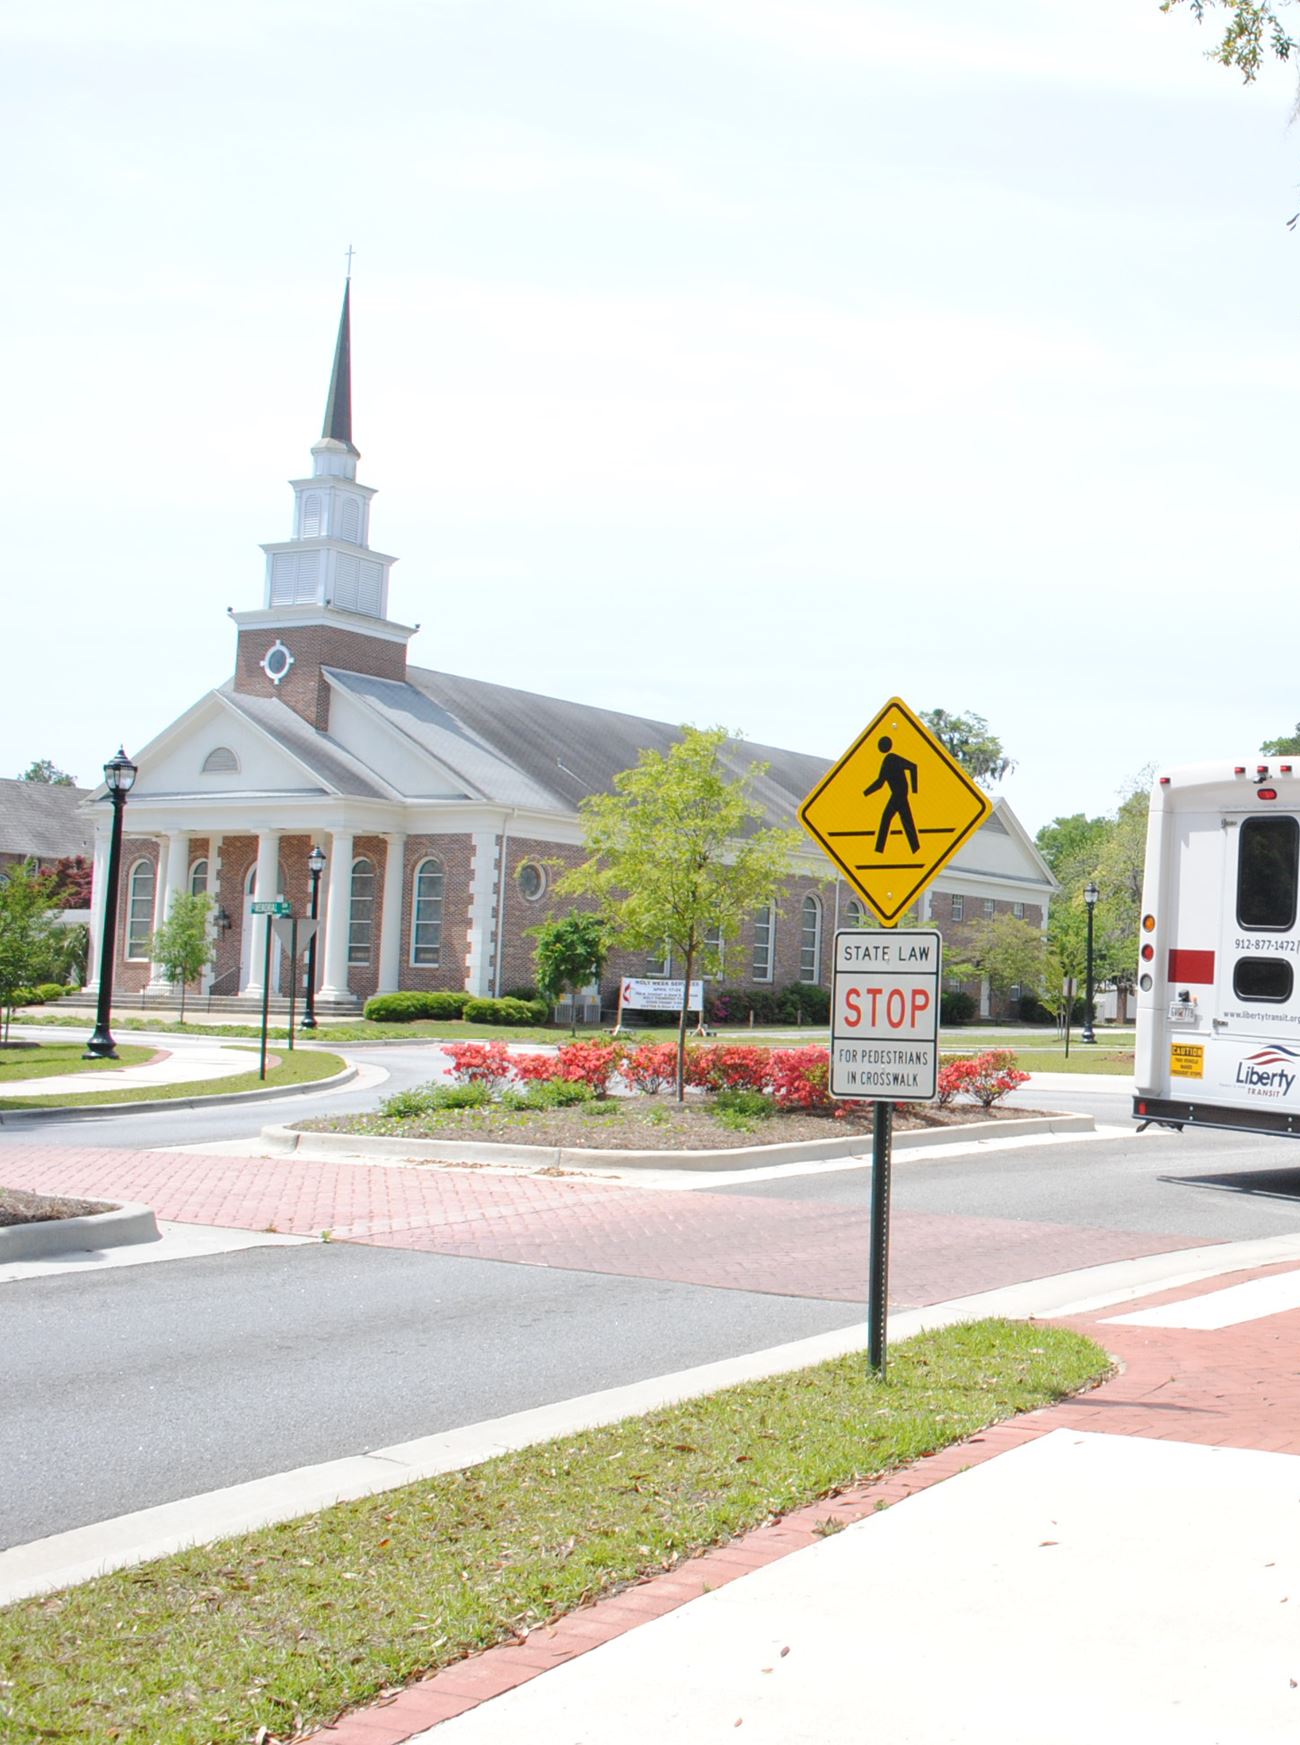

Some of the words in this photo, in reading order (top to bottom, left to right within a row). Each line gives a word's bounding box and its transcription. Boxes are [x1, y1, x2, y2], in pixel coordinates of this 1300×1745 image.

[844, 946, 890, 961] STATE
[898, 946, 930, 962] LAW
[1234, 939, 1296, 952] 912-877-1472
[843, 987, 930, 1029] STOP
[839, 1049, 858, 1063] FOR
[861, 1049, 929, 1066] PEDESTRIANS
[847, 1071, 857, 1085] IN
[860, 1071, 919, 1088] CROSSWALK
[1235, 1061, 1297, 1097] Liberty
[1247, 1087, 1281, 1098] TRANSIT
